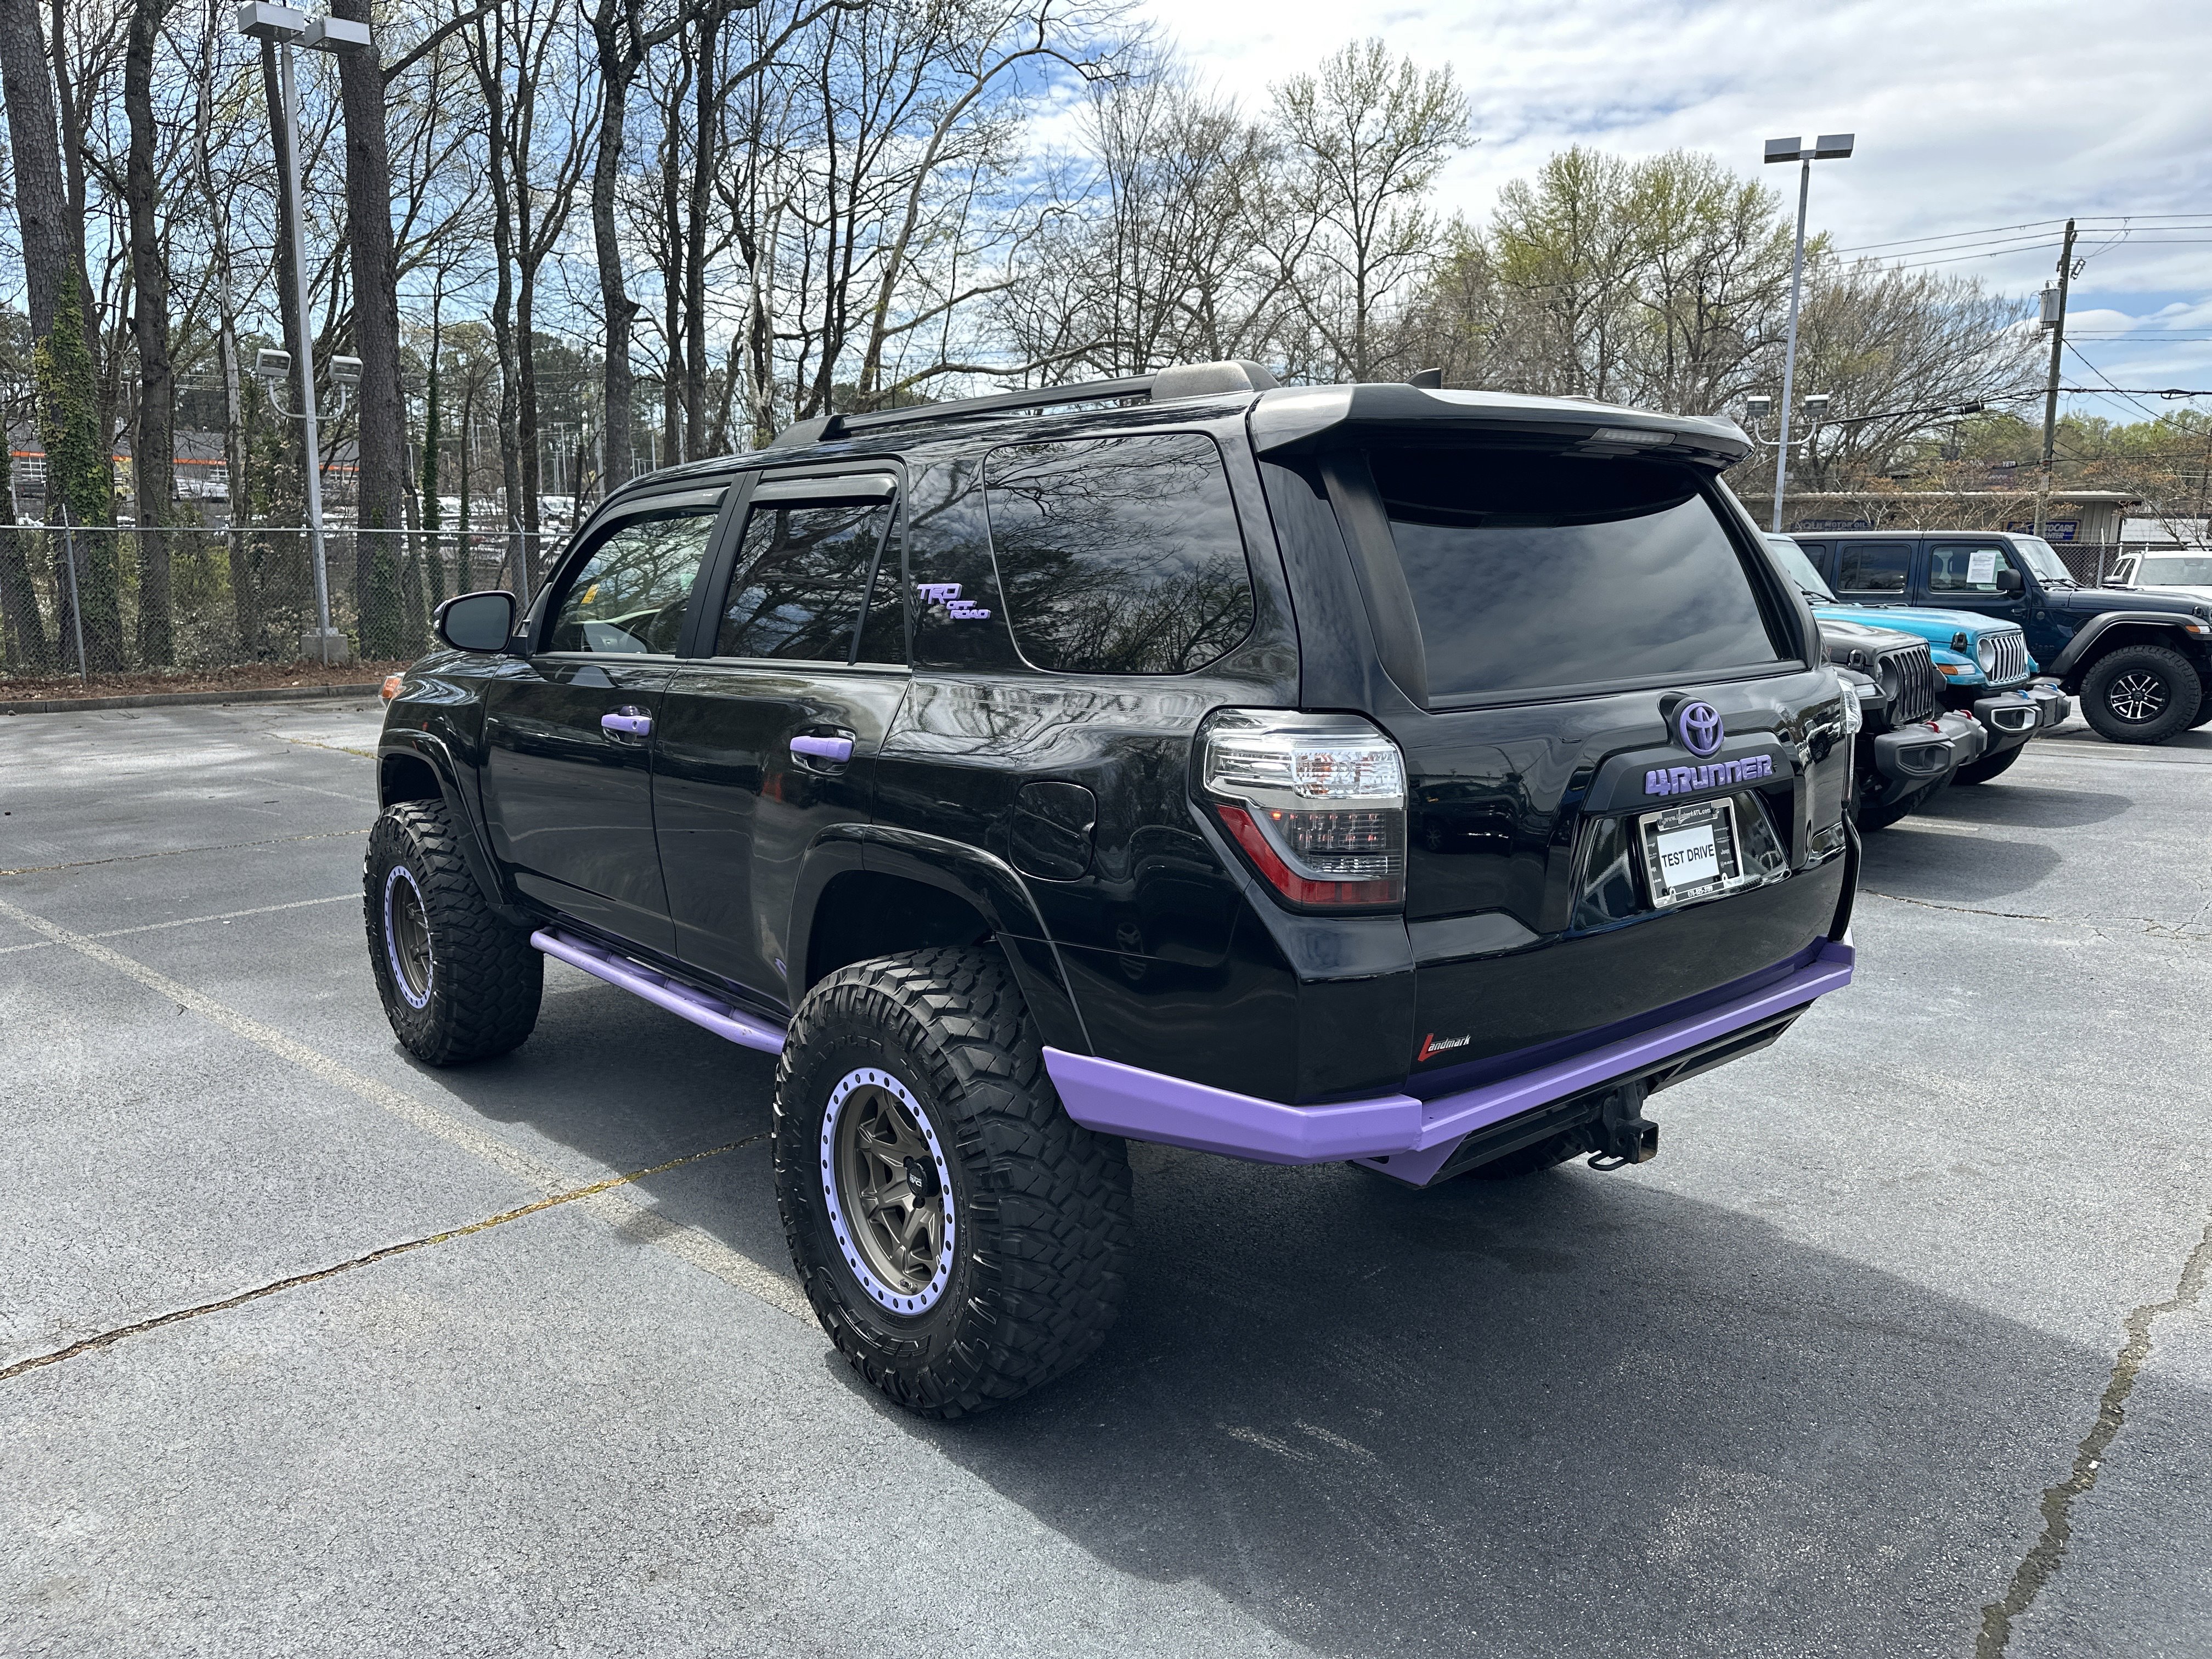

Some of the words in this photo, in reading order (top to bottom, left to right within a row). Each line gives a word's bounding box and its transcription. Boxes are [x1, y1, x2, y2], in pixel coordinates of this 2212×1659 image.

[2045, 523, 2075, 532] TOCARE
[917, 583, 962, 604] TRD
[946, 600, 978, 610] OFF
[950, 609, 991, 619] ROAD
[2031, 642, 2055, 651] Jeep
[1646, 754, 1773, 796] 4RUNNER
[1661, 851, 1684, 868] TEST
[1687, 844, 1715, 862] DRIVE
[1417, 1033, 1471, 1062] Landmark
